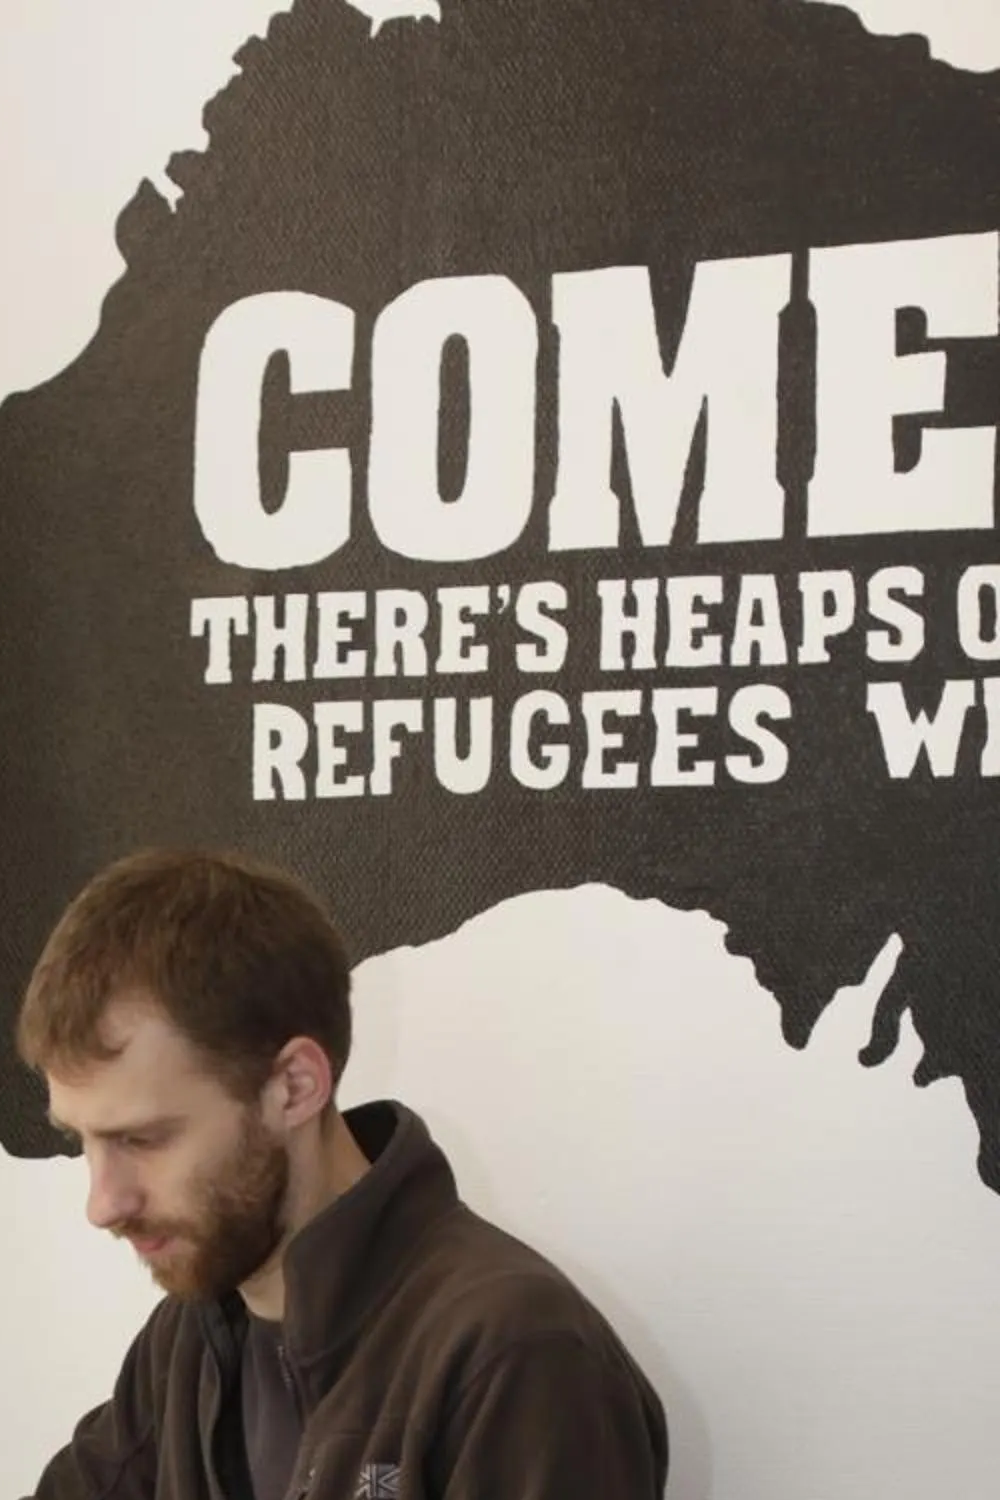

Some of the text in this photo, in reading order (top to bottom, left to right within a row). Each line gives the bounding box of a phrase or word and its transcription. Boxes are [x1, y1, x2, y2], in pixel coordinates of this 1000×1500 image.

[193, 230, 1000, 571] COME
[190, 580, 569, 684] THERE'S
[597, 565, 925, 671] HEAPS
[252, 683, 792, 801] REFUGEES
